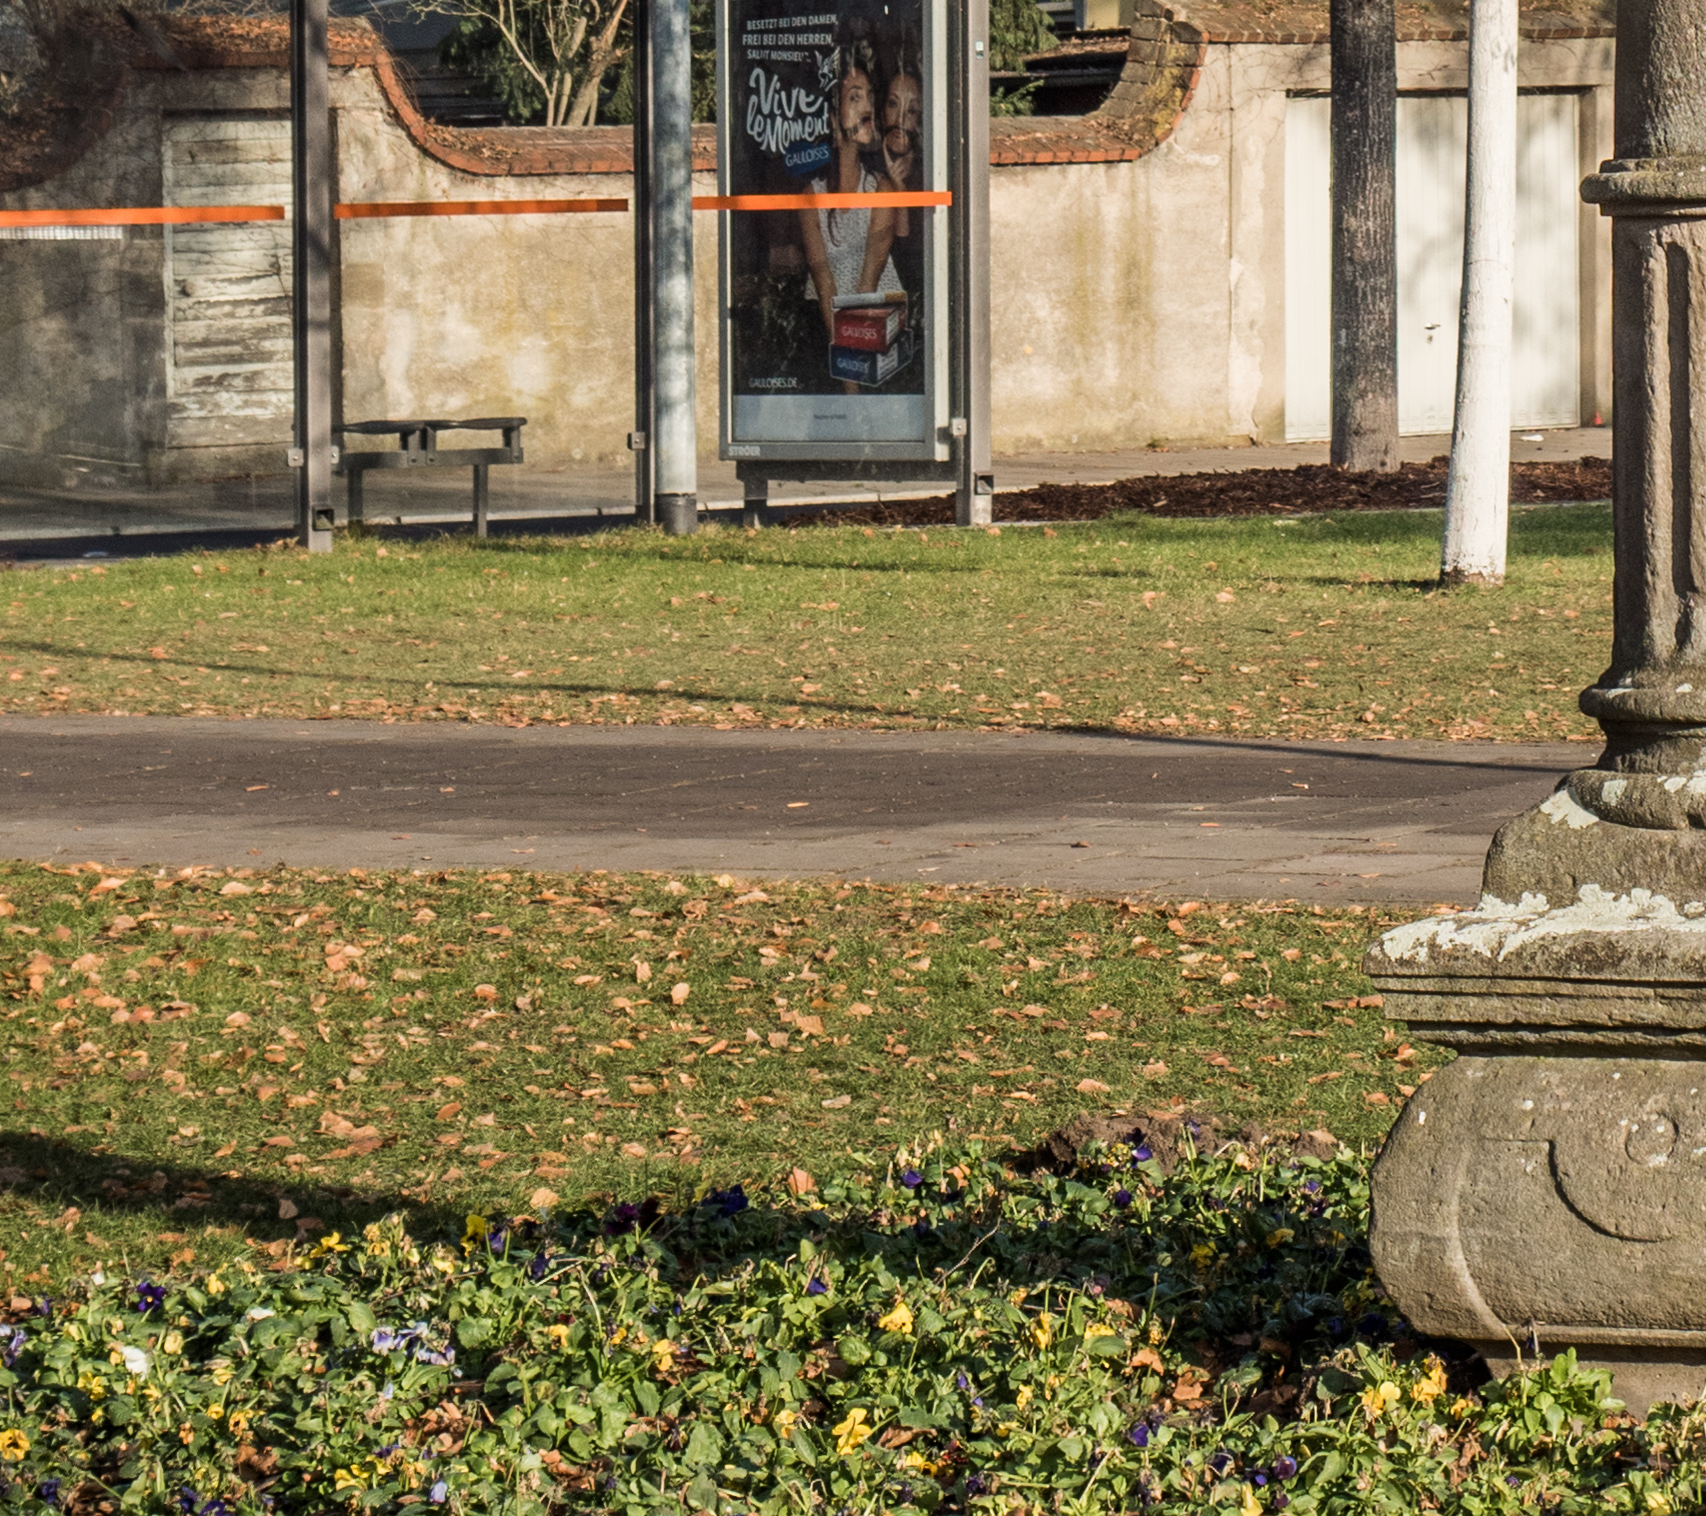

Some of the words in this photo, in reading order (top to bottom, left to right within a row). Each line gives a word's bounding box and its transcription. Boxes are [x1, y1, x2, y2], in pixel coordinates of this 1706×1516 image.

[746, 18, 778, 31] BESETZT
[778, 17, 791, 28] BEI
[791, 15, 807, 27] DEN
[742, 33, 761, 45] FREI
[762, 33, 776, 45] BEI
[777, 33, 795, 45] DEN
[796, 33, 835, 47] HERREN,
[746, 48, 770, 60] SALUT
[749, 67, 824, 119] Vive
[785, 145, 830, 167] GAULOISES
